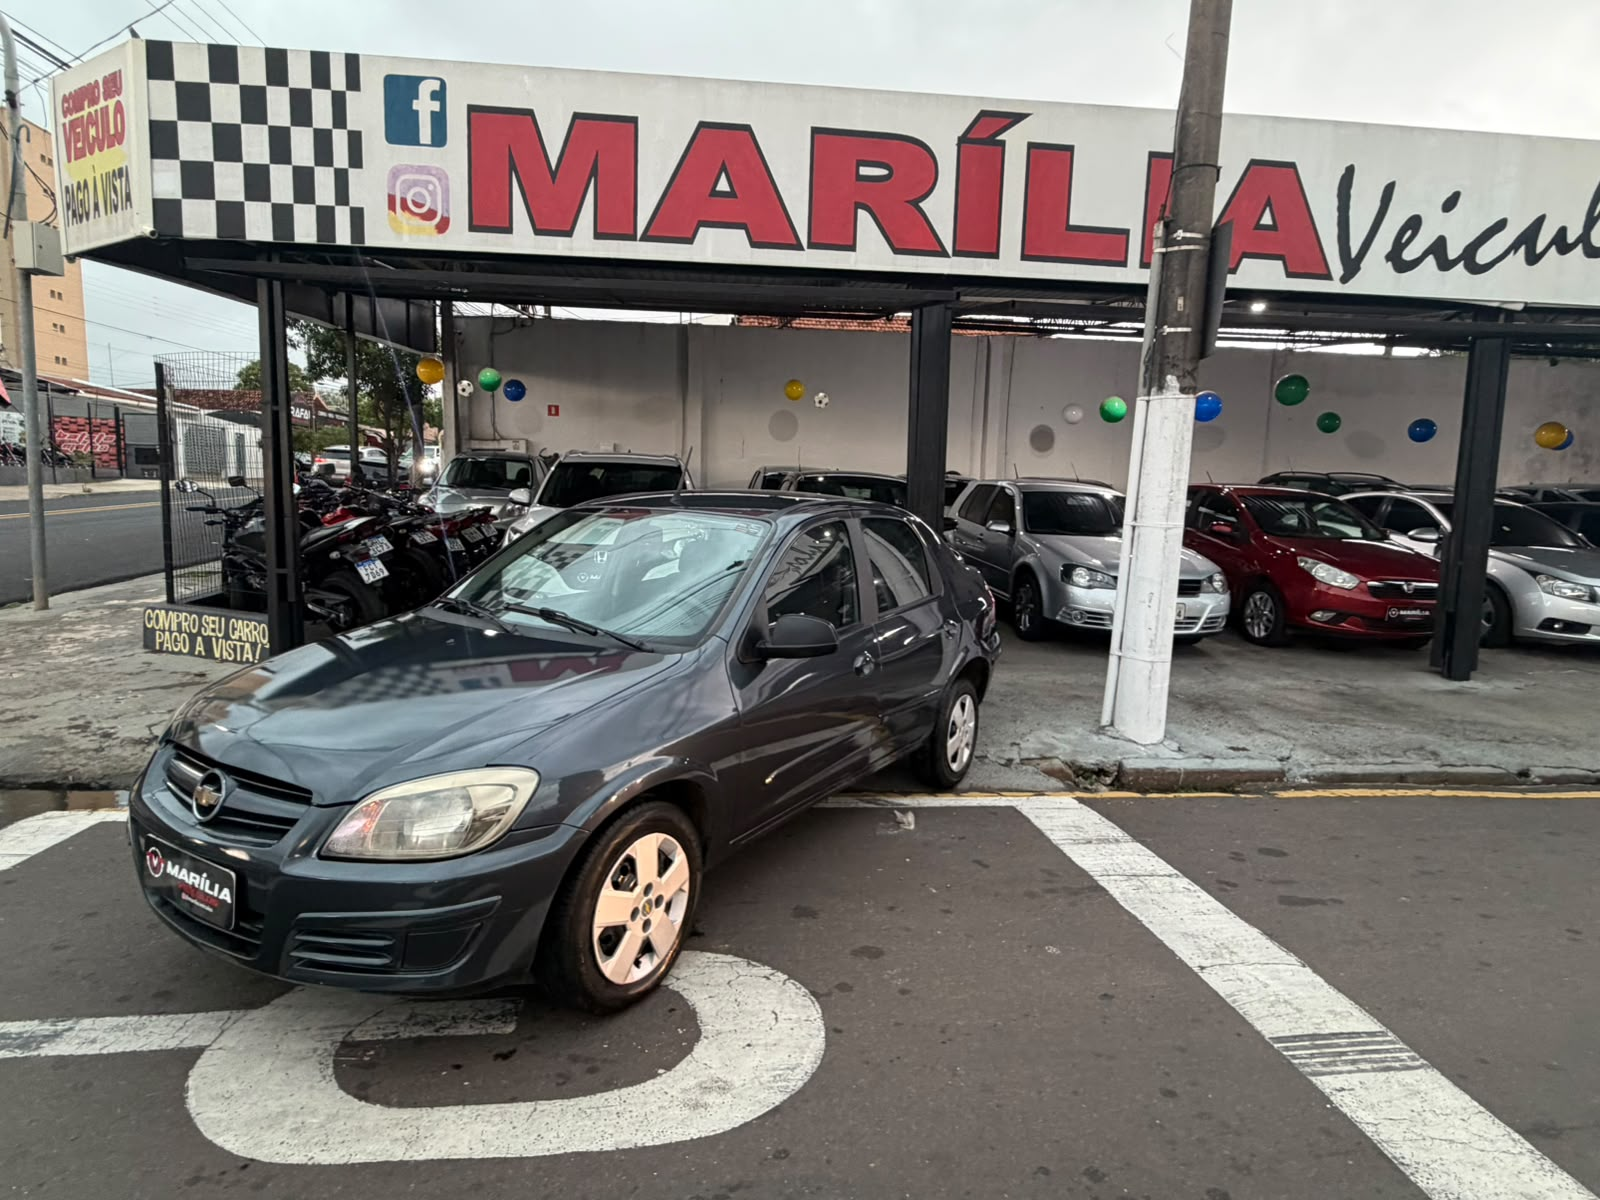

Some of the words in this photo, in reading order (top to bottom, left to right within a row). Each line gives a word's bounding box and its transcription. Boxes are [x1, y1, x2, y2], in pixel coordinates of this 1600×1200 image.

[61, 79, 101, 119] COMPRO
[102, 69, 123, 102] SEU
[64, 178, 91, 228] PAGO
[100, 164, 133, 217] VISTA
[144, 608, 199, 635] COMPRO
[201, 614, 225, 638] SEU
[155, 630, 190, 654] PAGO
[212, 637, 262, 664] VISTA!
[165, 860, 232, 904] MARÍLIA
